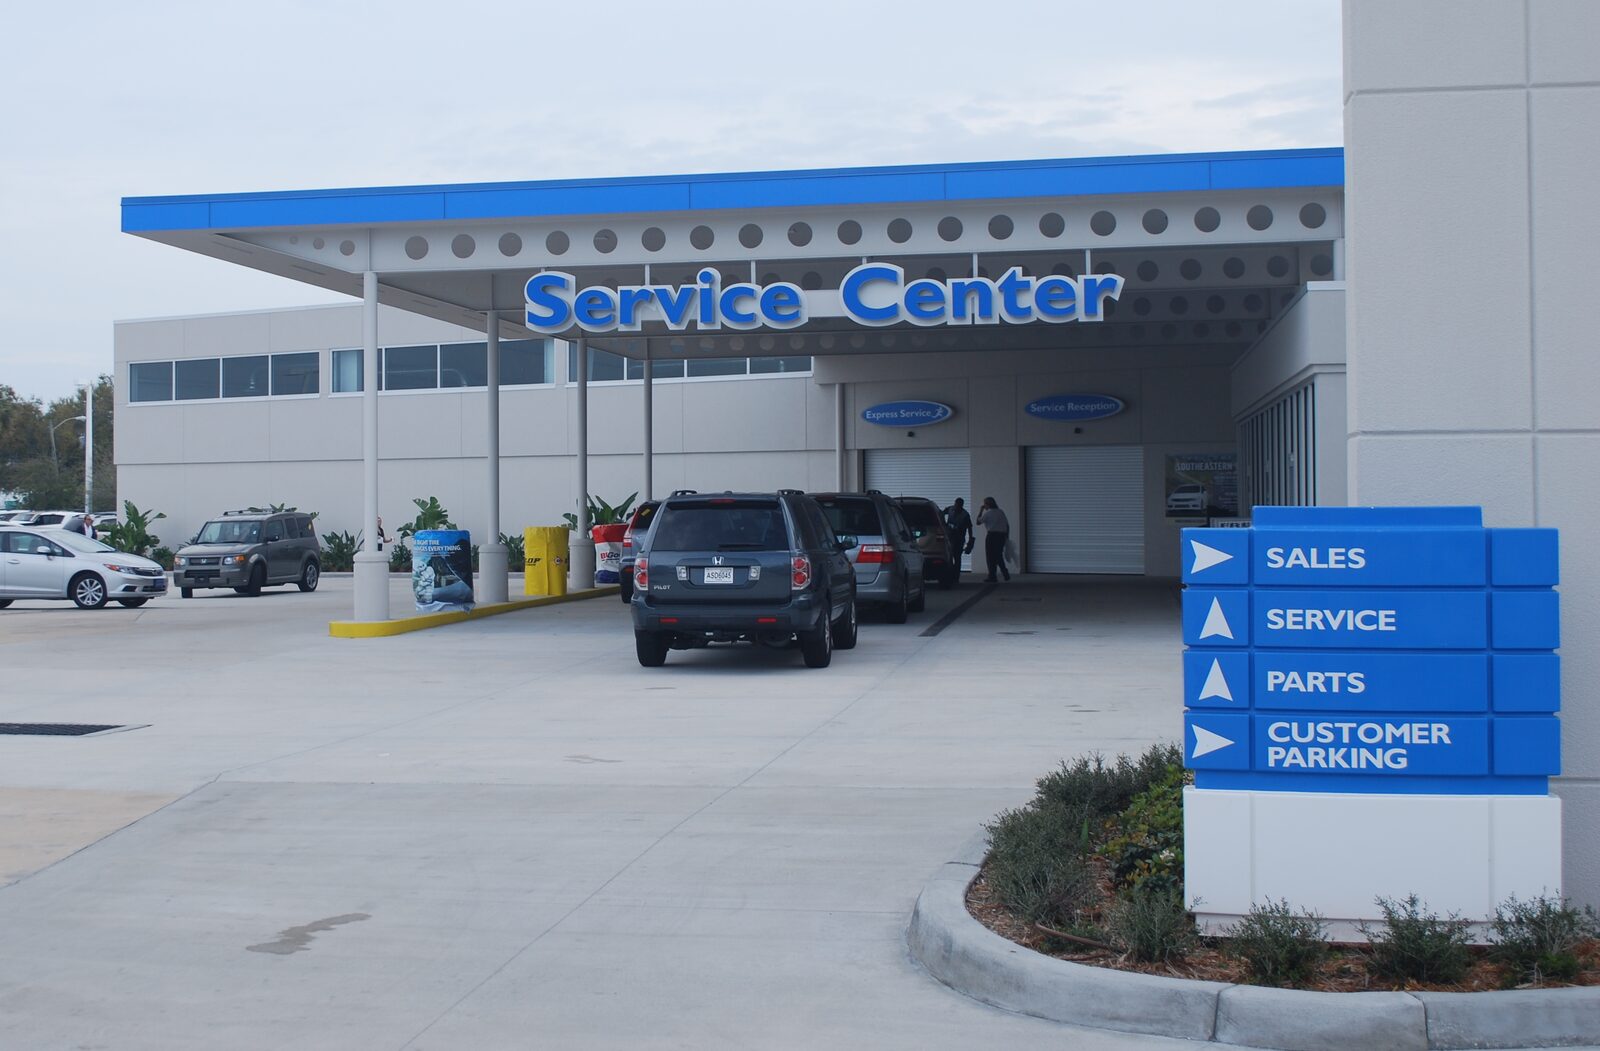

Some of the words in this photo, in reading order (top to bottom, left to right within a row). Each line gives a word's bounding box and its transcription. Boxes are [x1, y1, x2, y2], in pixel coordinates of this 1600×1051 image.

[525, 270, 803, 330] Service
[841, 263, 1123, 325] Center
[865, 410, 898, 420] Express
[900, 408, 931, 418] Service
[1030, 402, 1065, 413] Service
[1067, 400, 1116, 412] Reception
[1175, 462, 1234, 472] SOUTHEASTERN
[1266, 547, 1366, 569] SALES
[1267, 608, 1396, 631] SERVICE
[1267, 671, 1365, 694] PARTS
[1267, 721, 1452, 745] CUSTOMER
[1268, 747, 1408, 769] PARKING
